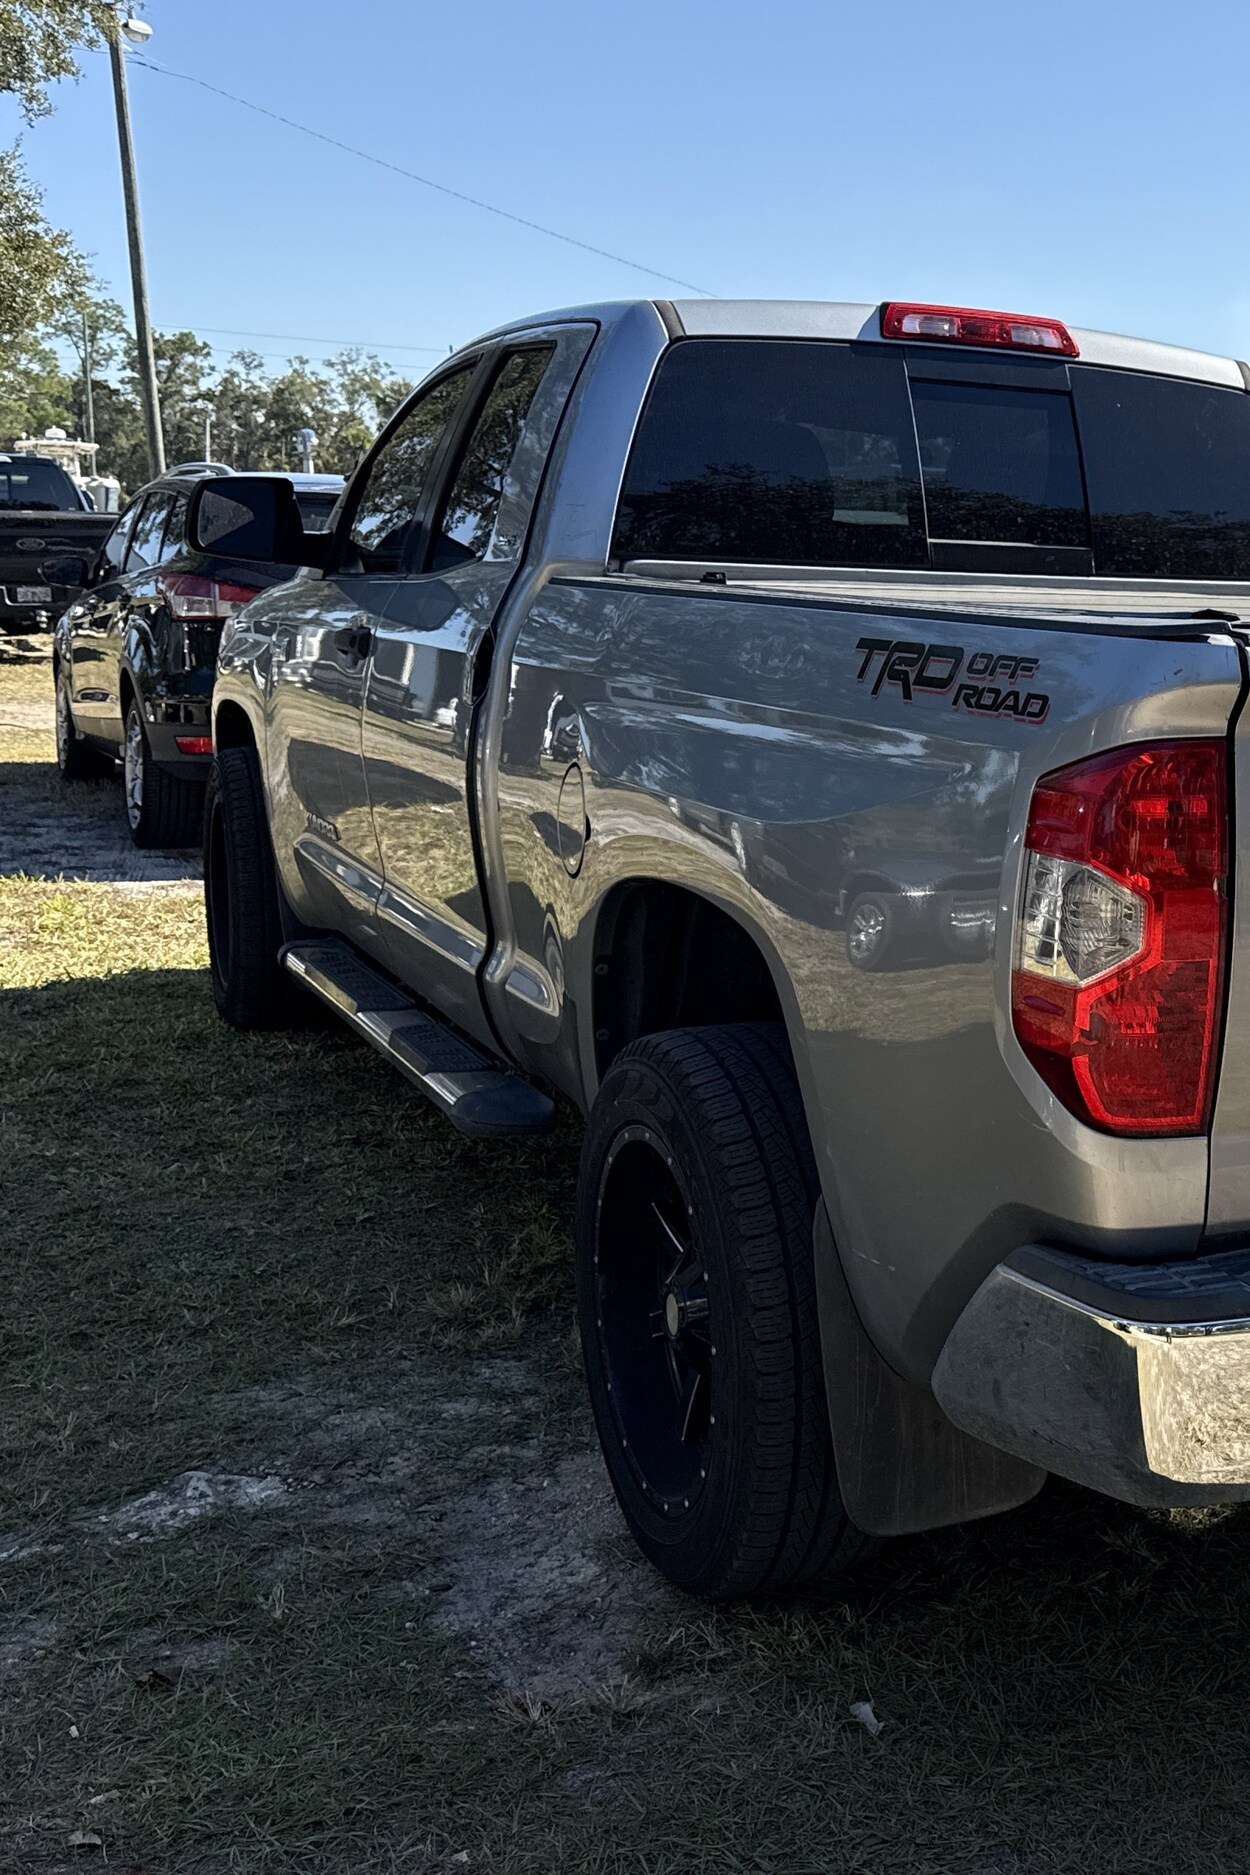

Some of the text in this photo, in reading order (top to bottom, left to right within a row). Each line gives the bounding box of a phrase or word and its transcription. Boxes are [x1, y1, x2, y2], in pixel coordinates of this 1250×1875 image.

[855, 637, 964, 704] TRD
[966, 652, 1040, 685] OFF
[951, 683, 1050, 725] ROAD
